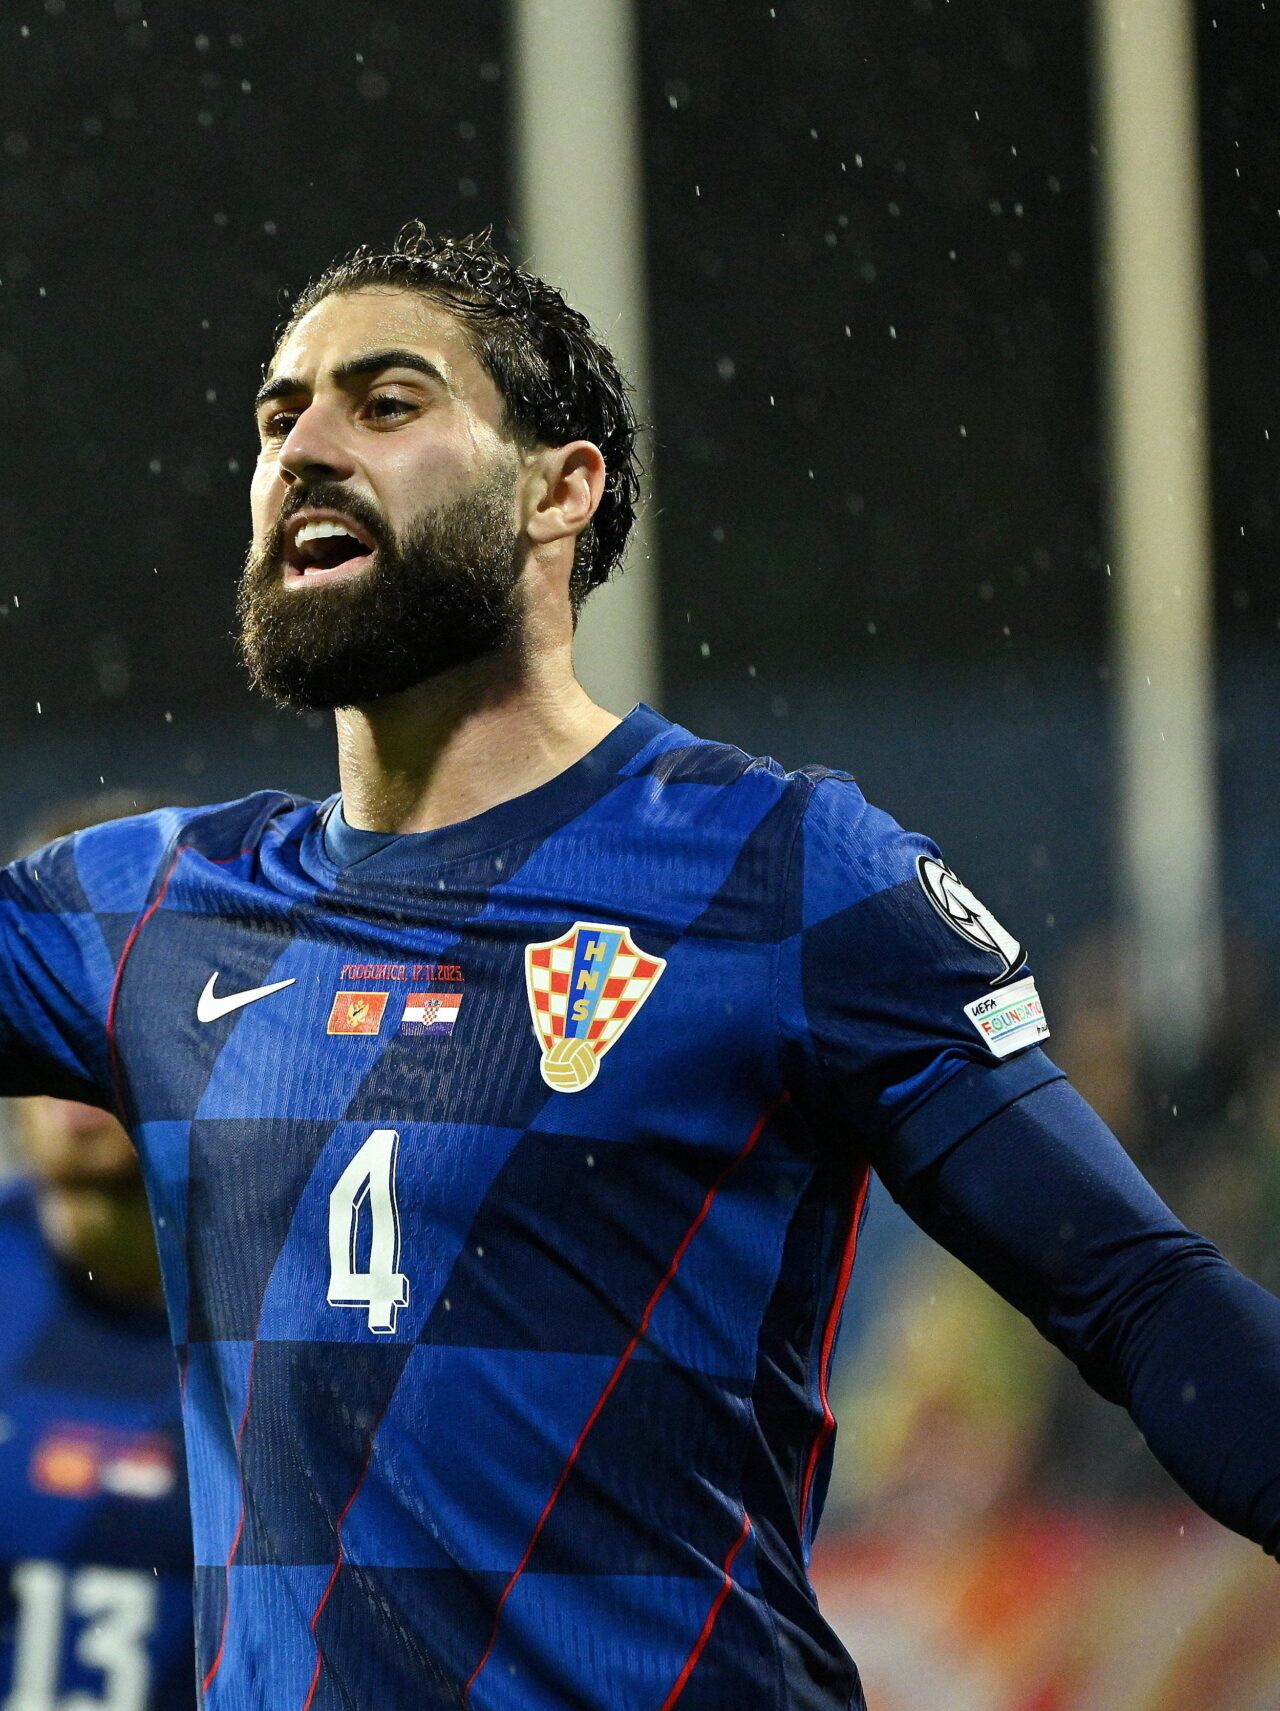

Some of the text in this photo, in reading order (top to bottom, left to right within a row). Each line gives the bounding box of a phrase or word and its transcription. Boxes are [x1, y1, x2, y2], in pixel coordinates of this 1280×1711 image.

[572, 940, 606, 1021] HNS
[971, 998, 997, 1017] UEFA
[981, 1000, 1043, 1035] FOUNDATIO
[327, 1129, 410, 1335] 4
[4, 1559, 158, 1711] 13
